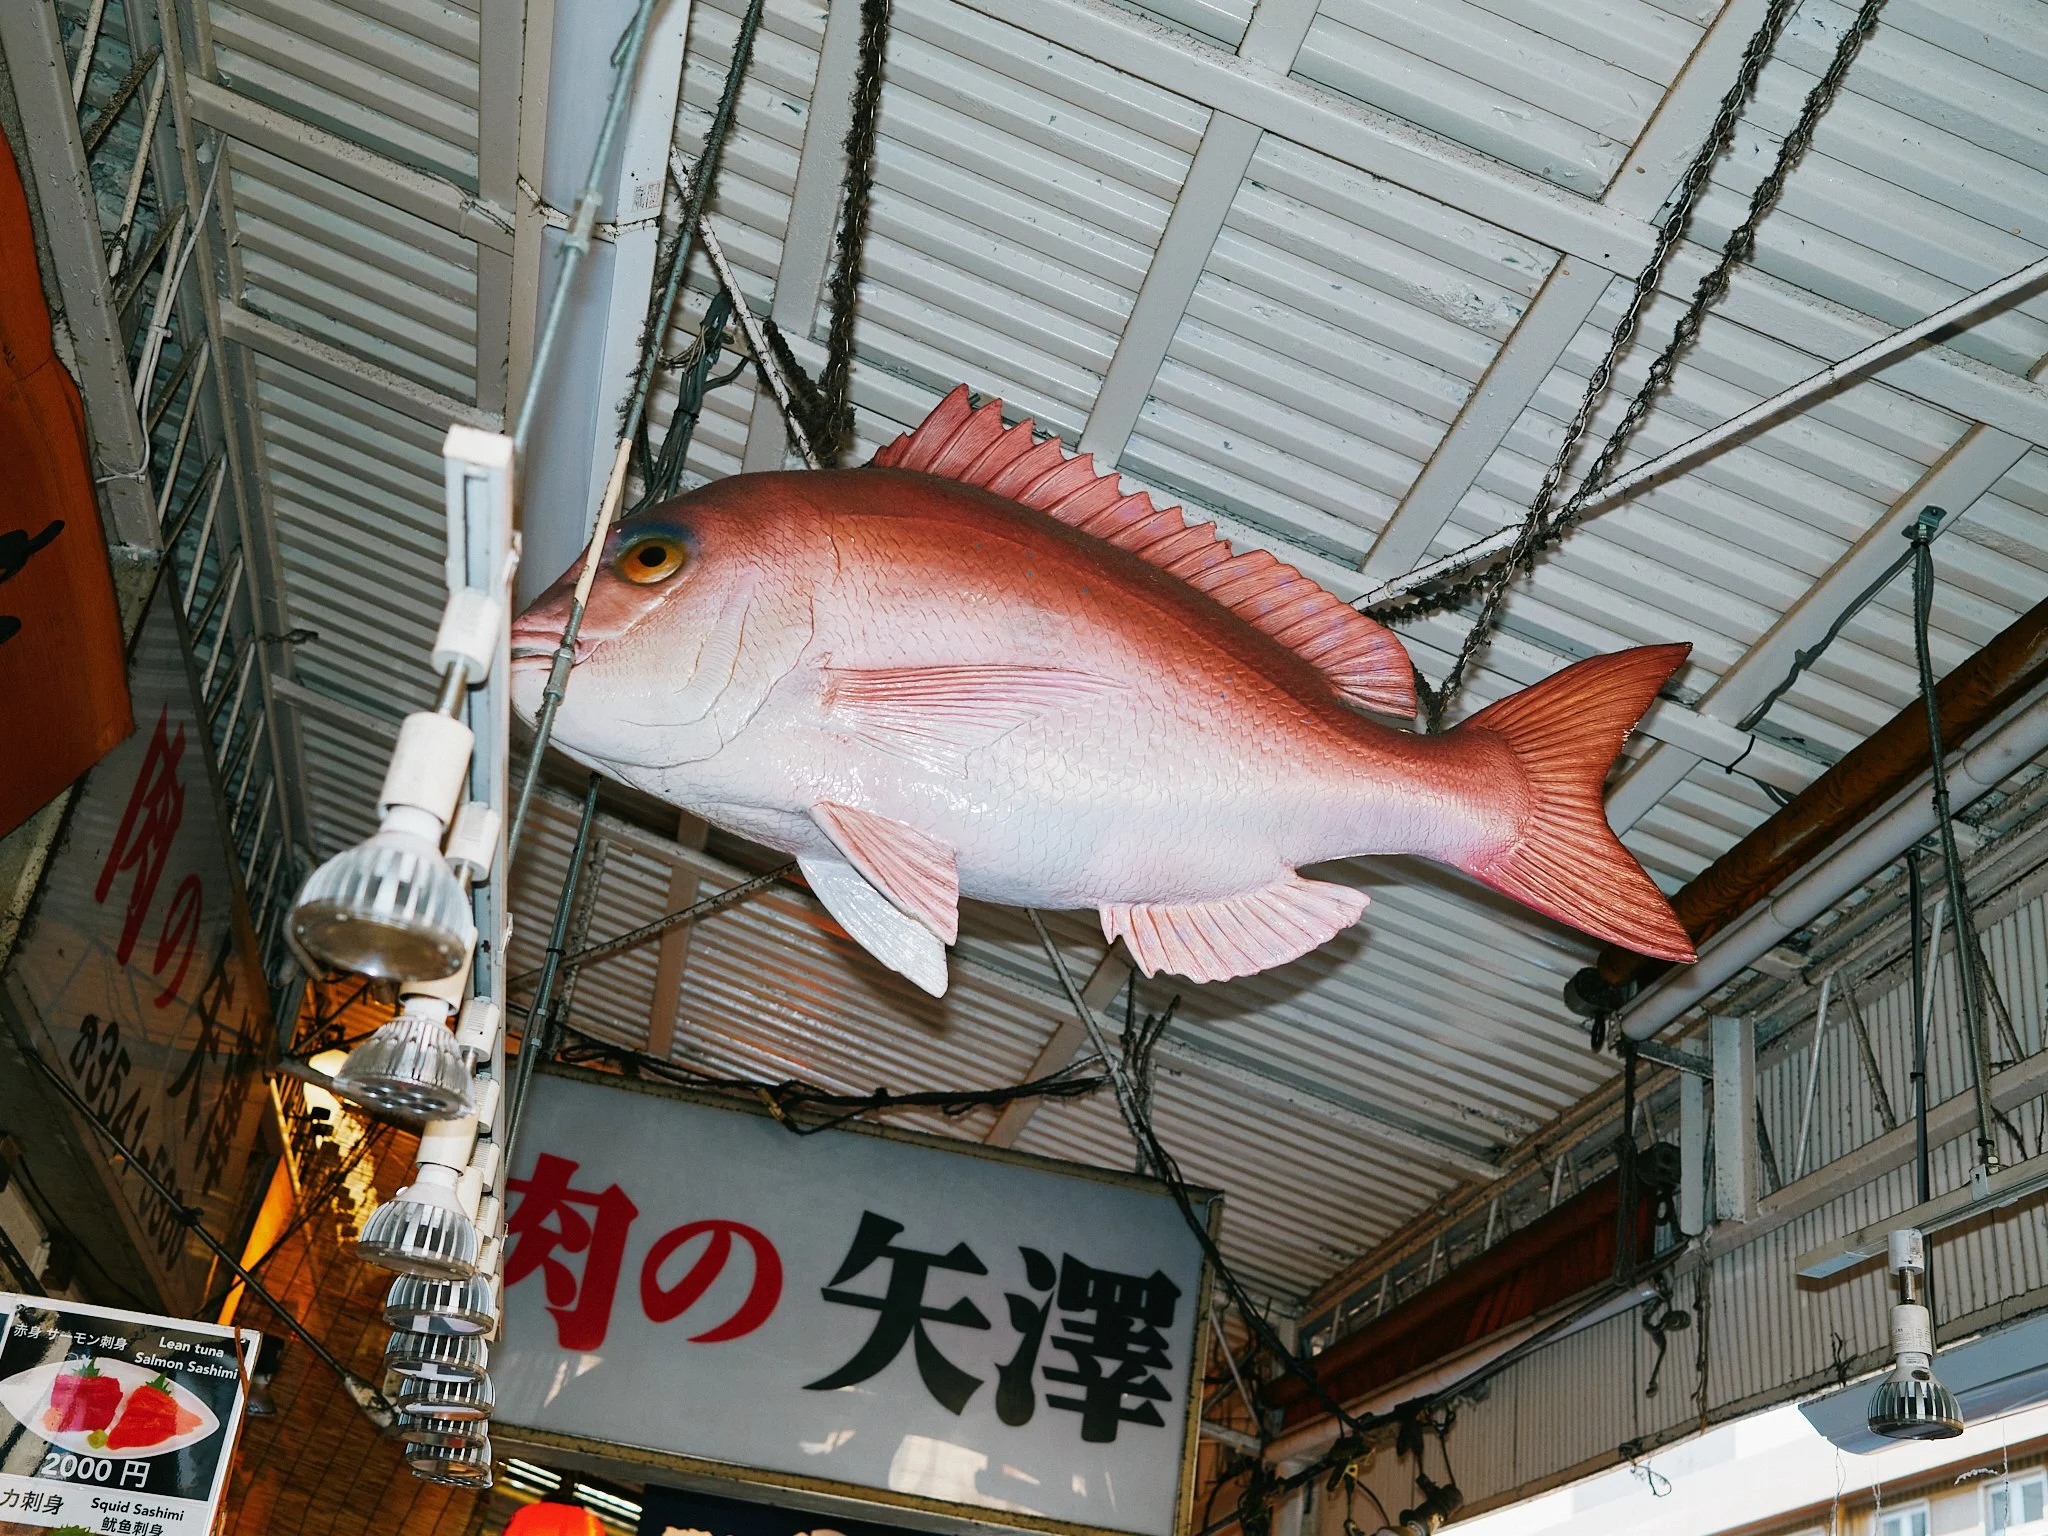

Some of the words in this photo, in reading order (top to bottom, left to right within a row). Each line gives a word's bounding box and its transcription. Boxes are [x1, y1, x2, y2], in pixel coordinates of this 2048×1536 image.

[504, 1152, 1182, 1443] 肉の矢澤
[14, 1322, 41, 1339] 赤身
[46, 1328, 128, 1351] サーモン刺身
[159, 1336, 191, 1353] Lean
[194, 1341, 225, 1358] tuna
[134, 1352, 184, 1371] Salmon
[187, 1361, 238, 1380] Sashimi
[41, 1453, 113, 1482] 2000
[119, 1460, 151, 1489] 円
[90, 1497, 131, 1515] Squid
[133, 1503, 185, 1522] Sashimi
